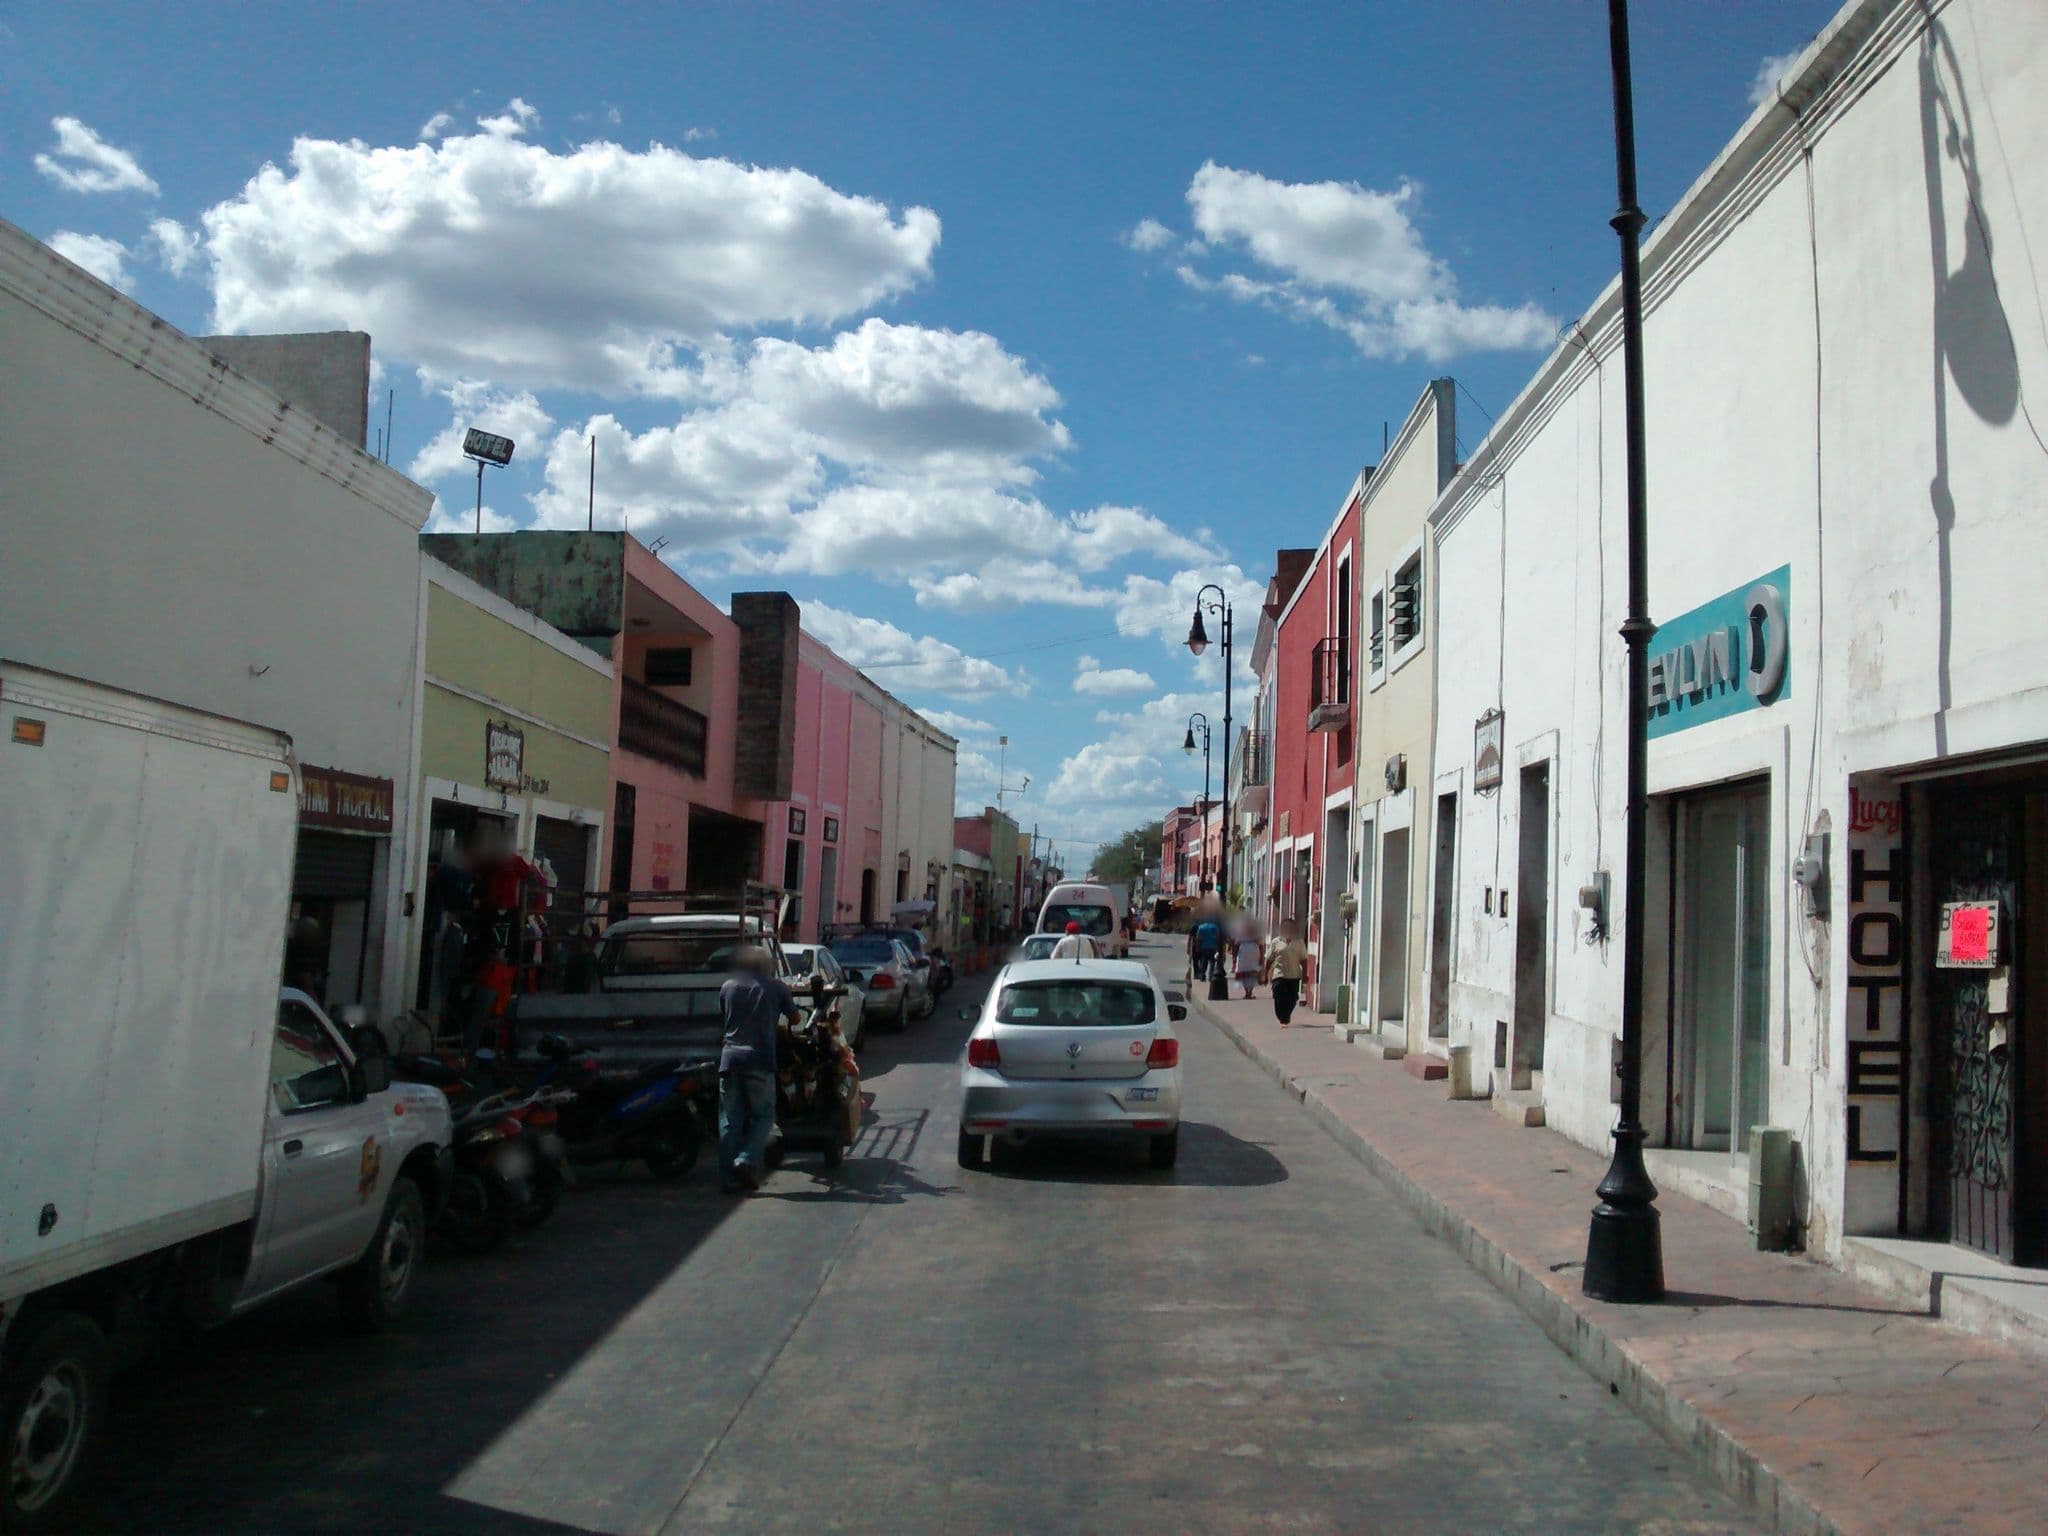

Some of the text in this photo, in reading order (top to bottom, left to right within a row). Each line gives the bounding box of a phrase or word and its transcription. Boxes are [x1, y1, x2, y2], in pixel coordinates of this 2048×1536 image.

[464, 429, 508, 458] HOTEL
[1648, 627, 1738, 707] EVLYN
[300, 778, 390, 821] TINA TROPICAL
[452, 783, 459, 801] A
[1848, 786, 1903, 834] Lucy
[1848, 849, 1903, 1162] HOTEL
